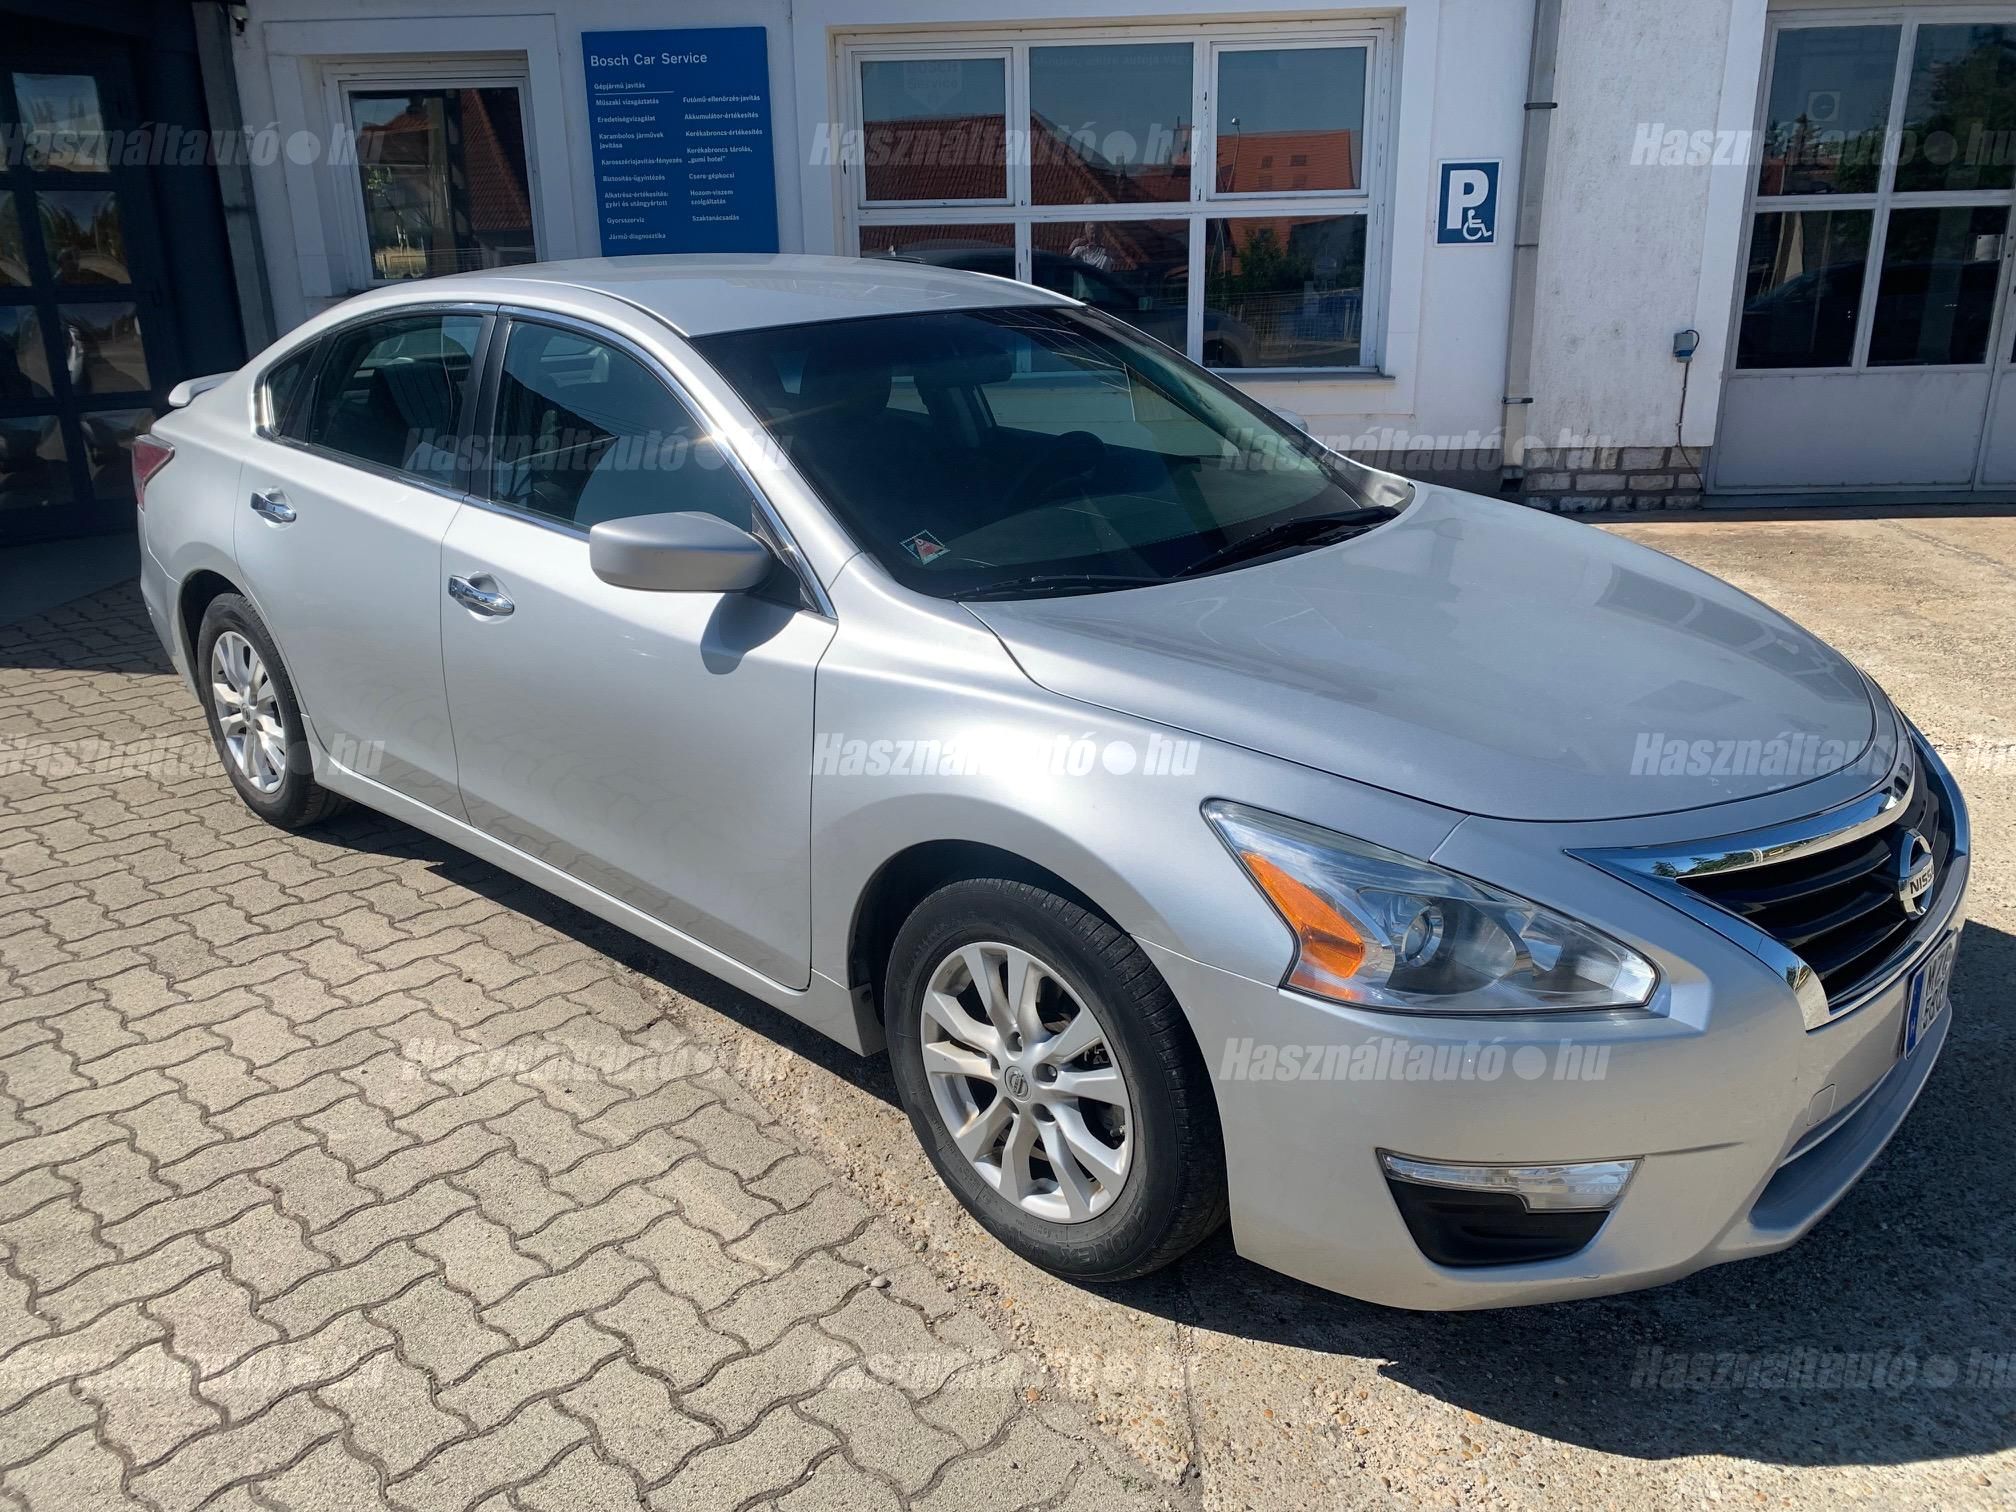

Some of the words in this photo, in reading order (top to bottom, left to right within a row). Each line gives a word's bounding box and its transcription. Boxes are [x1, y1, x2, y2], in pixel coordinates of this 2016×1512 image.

[590, 54, 629, 66] Bosch
[633, 53, 656, 65] Car
[661, 52, 708, 64] Service
[625, 82, 646, 90] javítás
[598, 132, 635, 140] Karambolos
[636, 131, 665, 140] járművek
[1446, 169, 1490, 230] P
